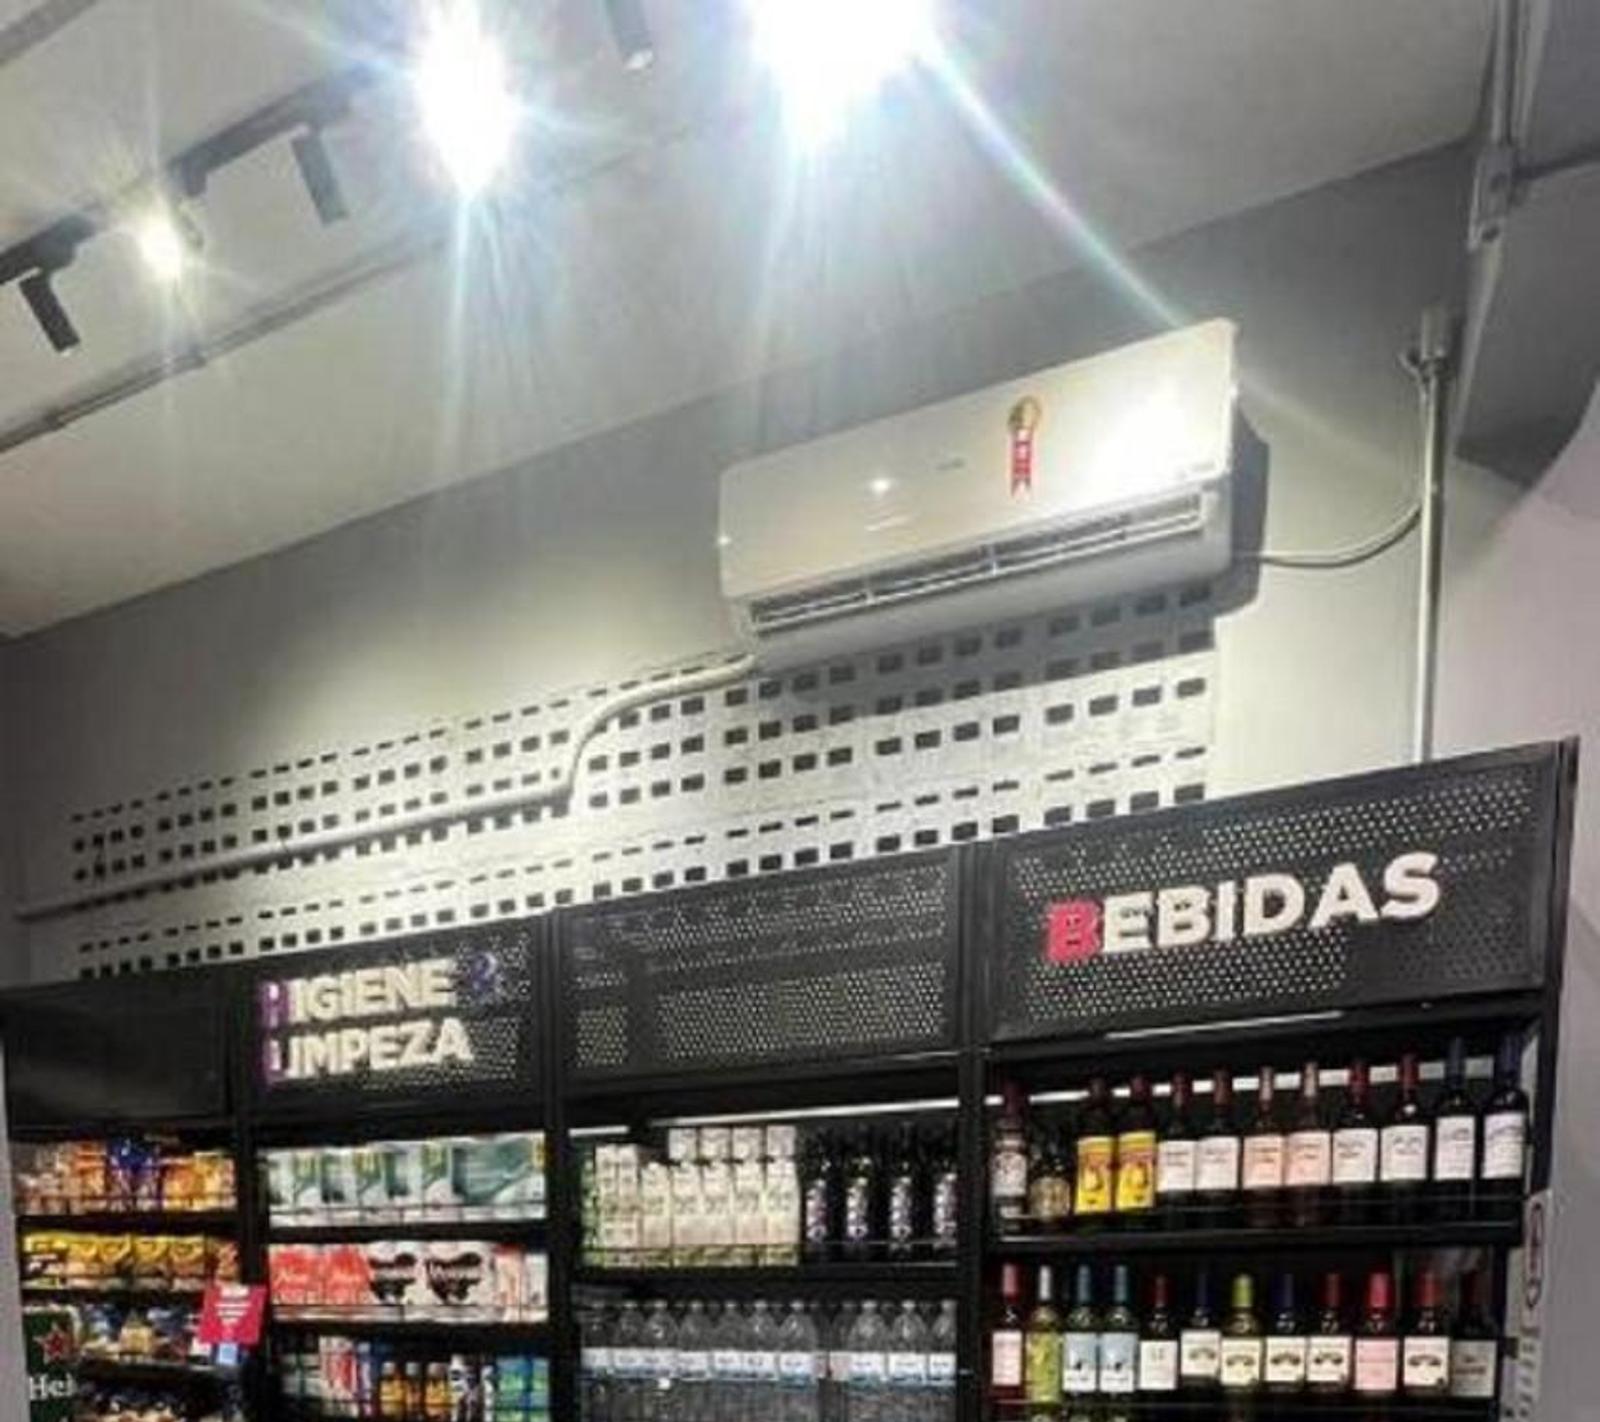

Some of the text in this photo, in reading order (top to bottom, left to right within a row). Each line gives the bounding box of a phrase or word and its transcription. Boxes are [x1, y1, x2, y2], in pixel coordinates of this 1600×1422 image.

[1044, 851, 1441, 963] BEBIDAS
[259, 957, 457, 1028] HIGIENE
[262, 1017, 474, 1081] LIMPEZA
